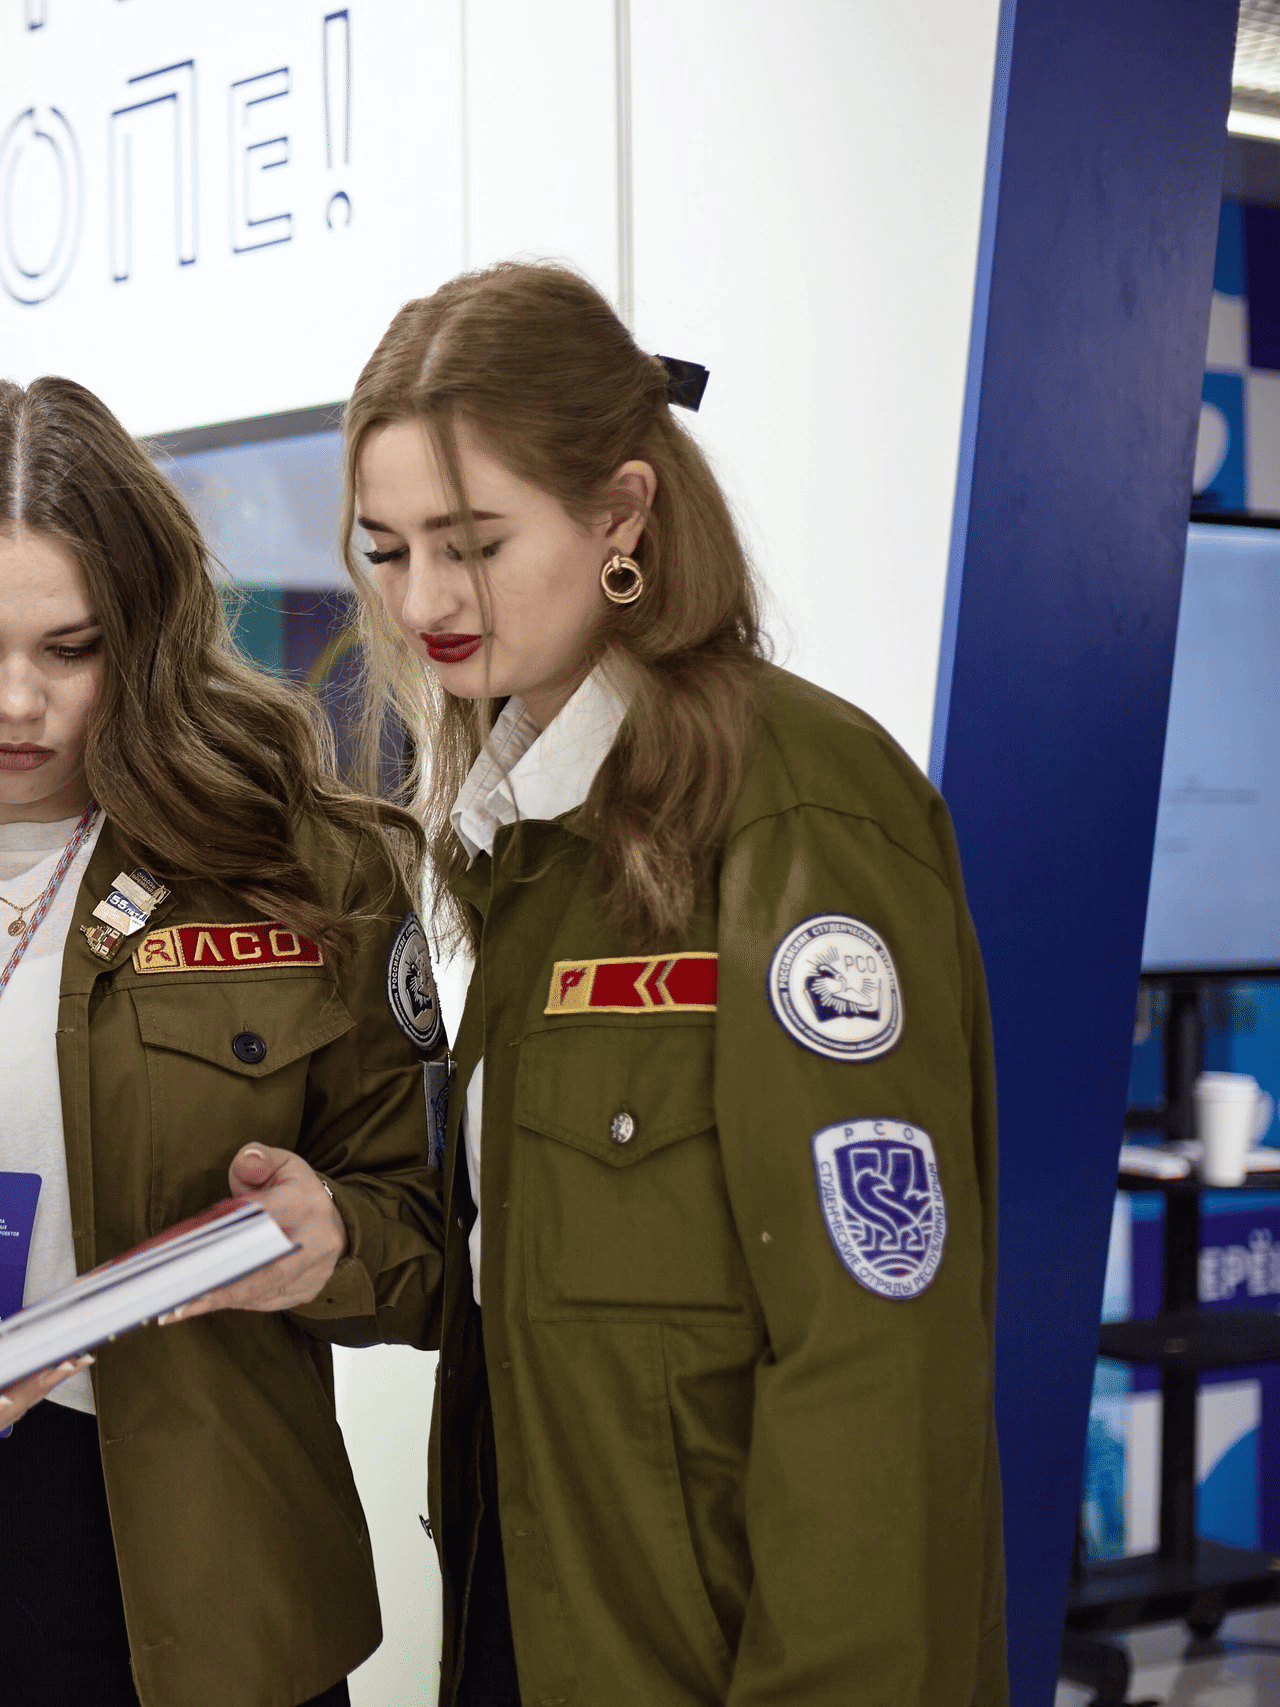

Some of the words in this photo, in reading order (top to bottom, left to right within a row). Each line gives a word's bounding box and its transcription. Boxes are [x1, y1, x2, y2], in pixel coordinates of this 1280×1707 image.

[109, 894, 129, 910] 55
[391, 936, 408, 990] РОССИЙСКИЕ
[779, 931, 812, 989] РОССИЙСКИЕ
[811, 923, 879, 950] СТУДЕНЧЕСКИЕ
[844, 954, 877, 974] РСО
[927, 1161, 943, 1203] КРЫМ
[820, 1161, 862, 1267] СТУДЕНЧЕСКИЕ
[913, 1205, 945, 1288] РЕСПУБЛИКИ
[858, 1266, 913, 1296] ОТРЯДЫ
